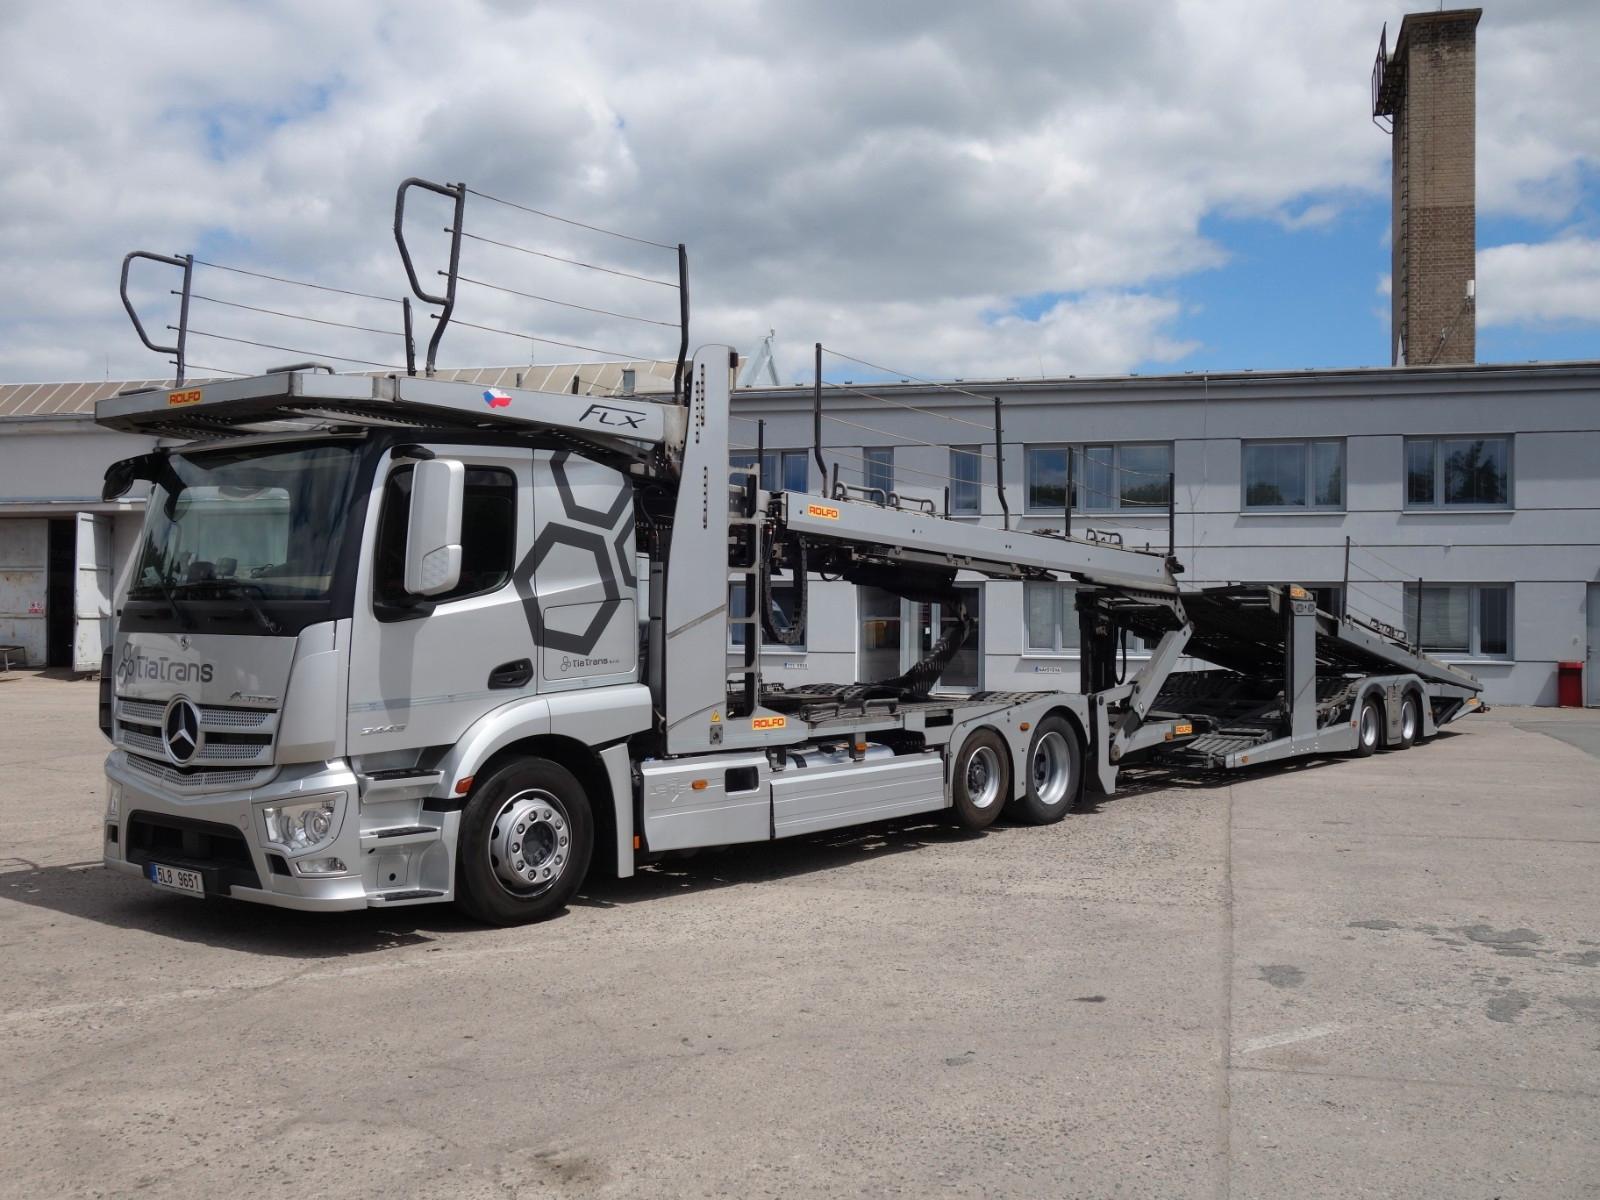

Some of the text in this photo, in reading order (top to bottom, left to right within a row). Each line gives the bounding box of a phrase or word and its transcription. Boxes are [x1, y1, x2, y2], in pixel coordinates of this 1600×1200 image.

[169, 390, 201, 405] ROLFO
[579, 404, 647, 429] FLX
[809, 506, 838, 518] ROLFO
[136, 655, 214, 683] TiaTrans
[753, 717, 785, 729] ROLFO
[177, 871, 200, 889] 9651
